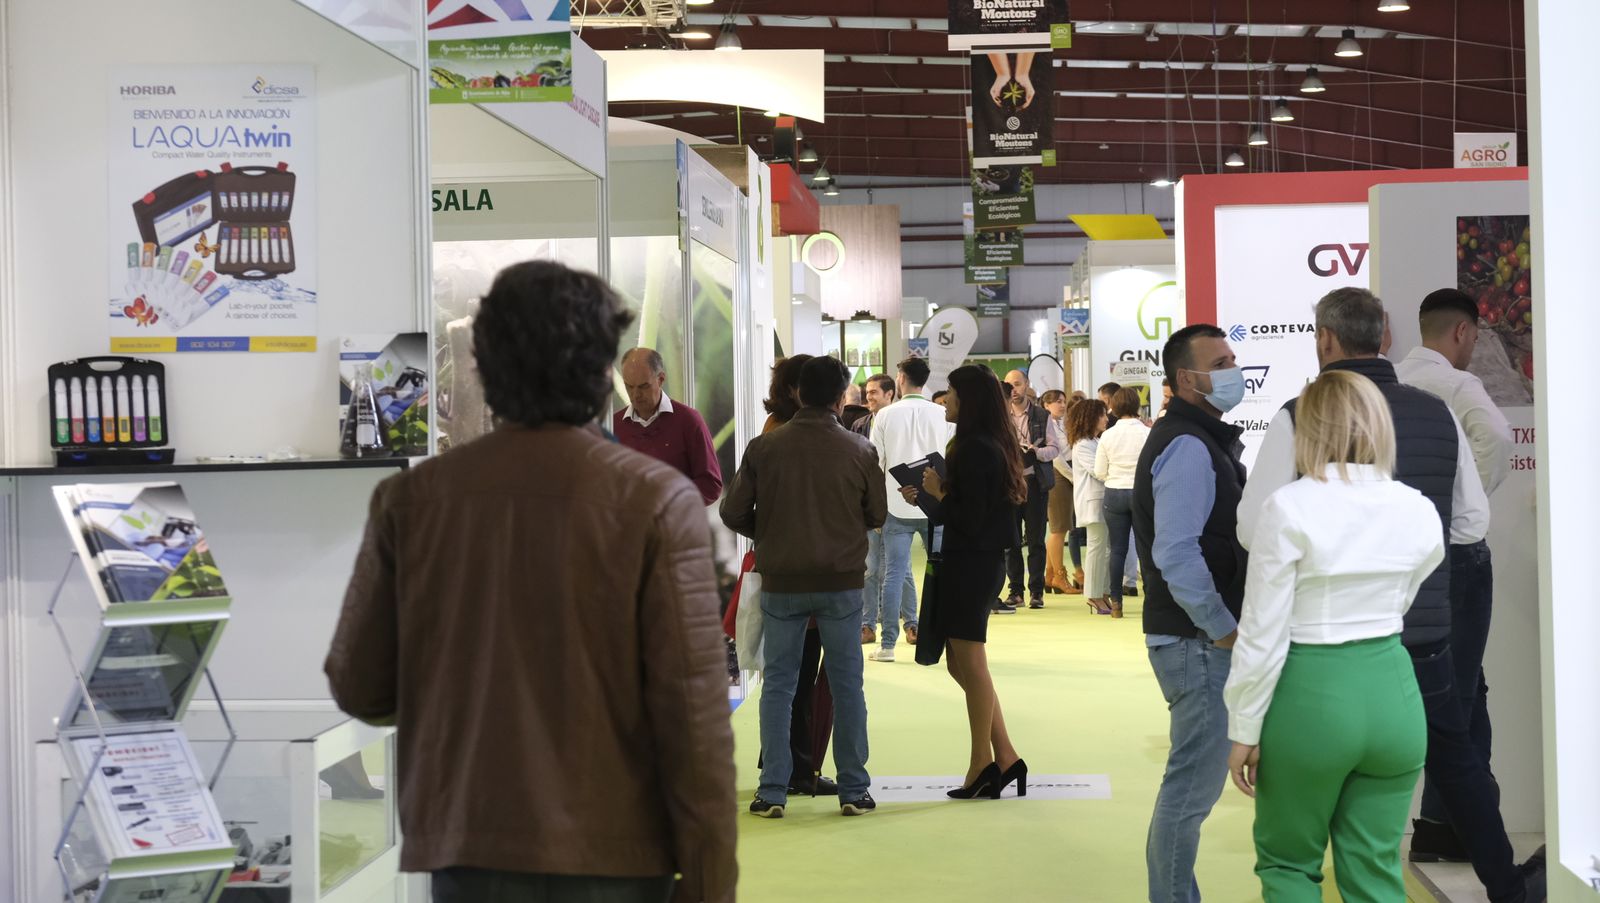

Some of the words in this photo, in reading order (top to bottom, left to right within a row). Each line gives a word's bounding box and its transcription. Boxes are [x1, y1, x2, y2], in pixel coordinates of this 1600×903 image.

[973, 0, 1044, 9] BioNatural
[981, 9, 1036, 19] Moutons
[120, 85, 176, 95] HORIBA
[263, 84, 299, 95] dicsa
[133, 109, 195, 119] BIENVENIDO
[199, 109, 207, 119] A
[209, 109, 223, 119] LA
[226, 108, 290, 119] INNOVACIÓN
[990, 132, 1038, 141] BioNatural
[995, 140, 1033, 148] Moutons
[152, 151, 184, 159] Compact
[207, 151, 231, 159] Quality
[1461, 149, 1507, 161] AGRO
[979, 196, 1028, 205] Comprometidos
[988, 204, 1019, 212] Eficientes
[988, 212, 1021, 220] Ecológicos
[1251, 324, 1315, 334] CORTEVA
[1123, 367, 1147, 375] GINEGAR
